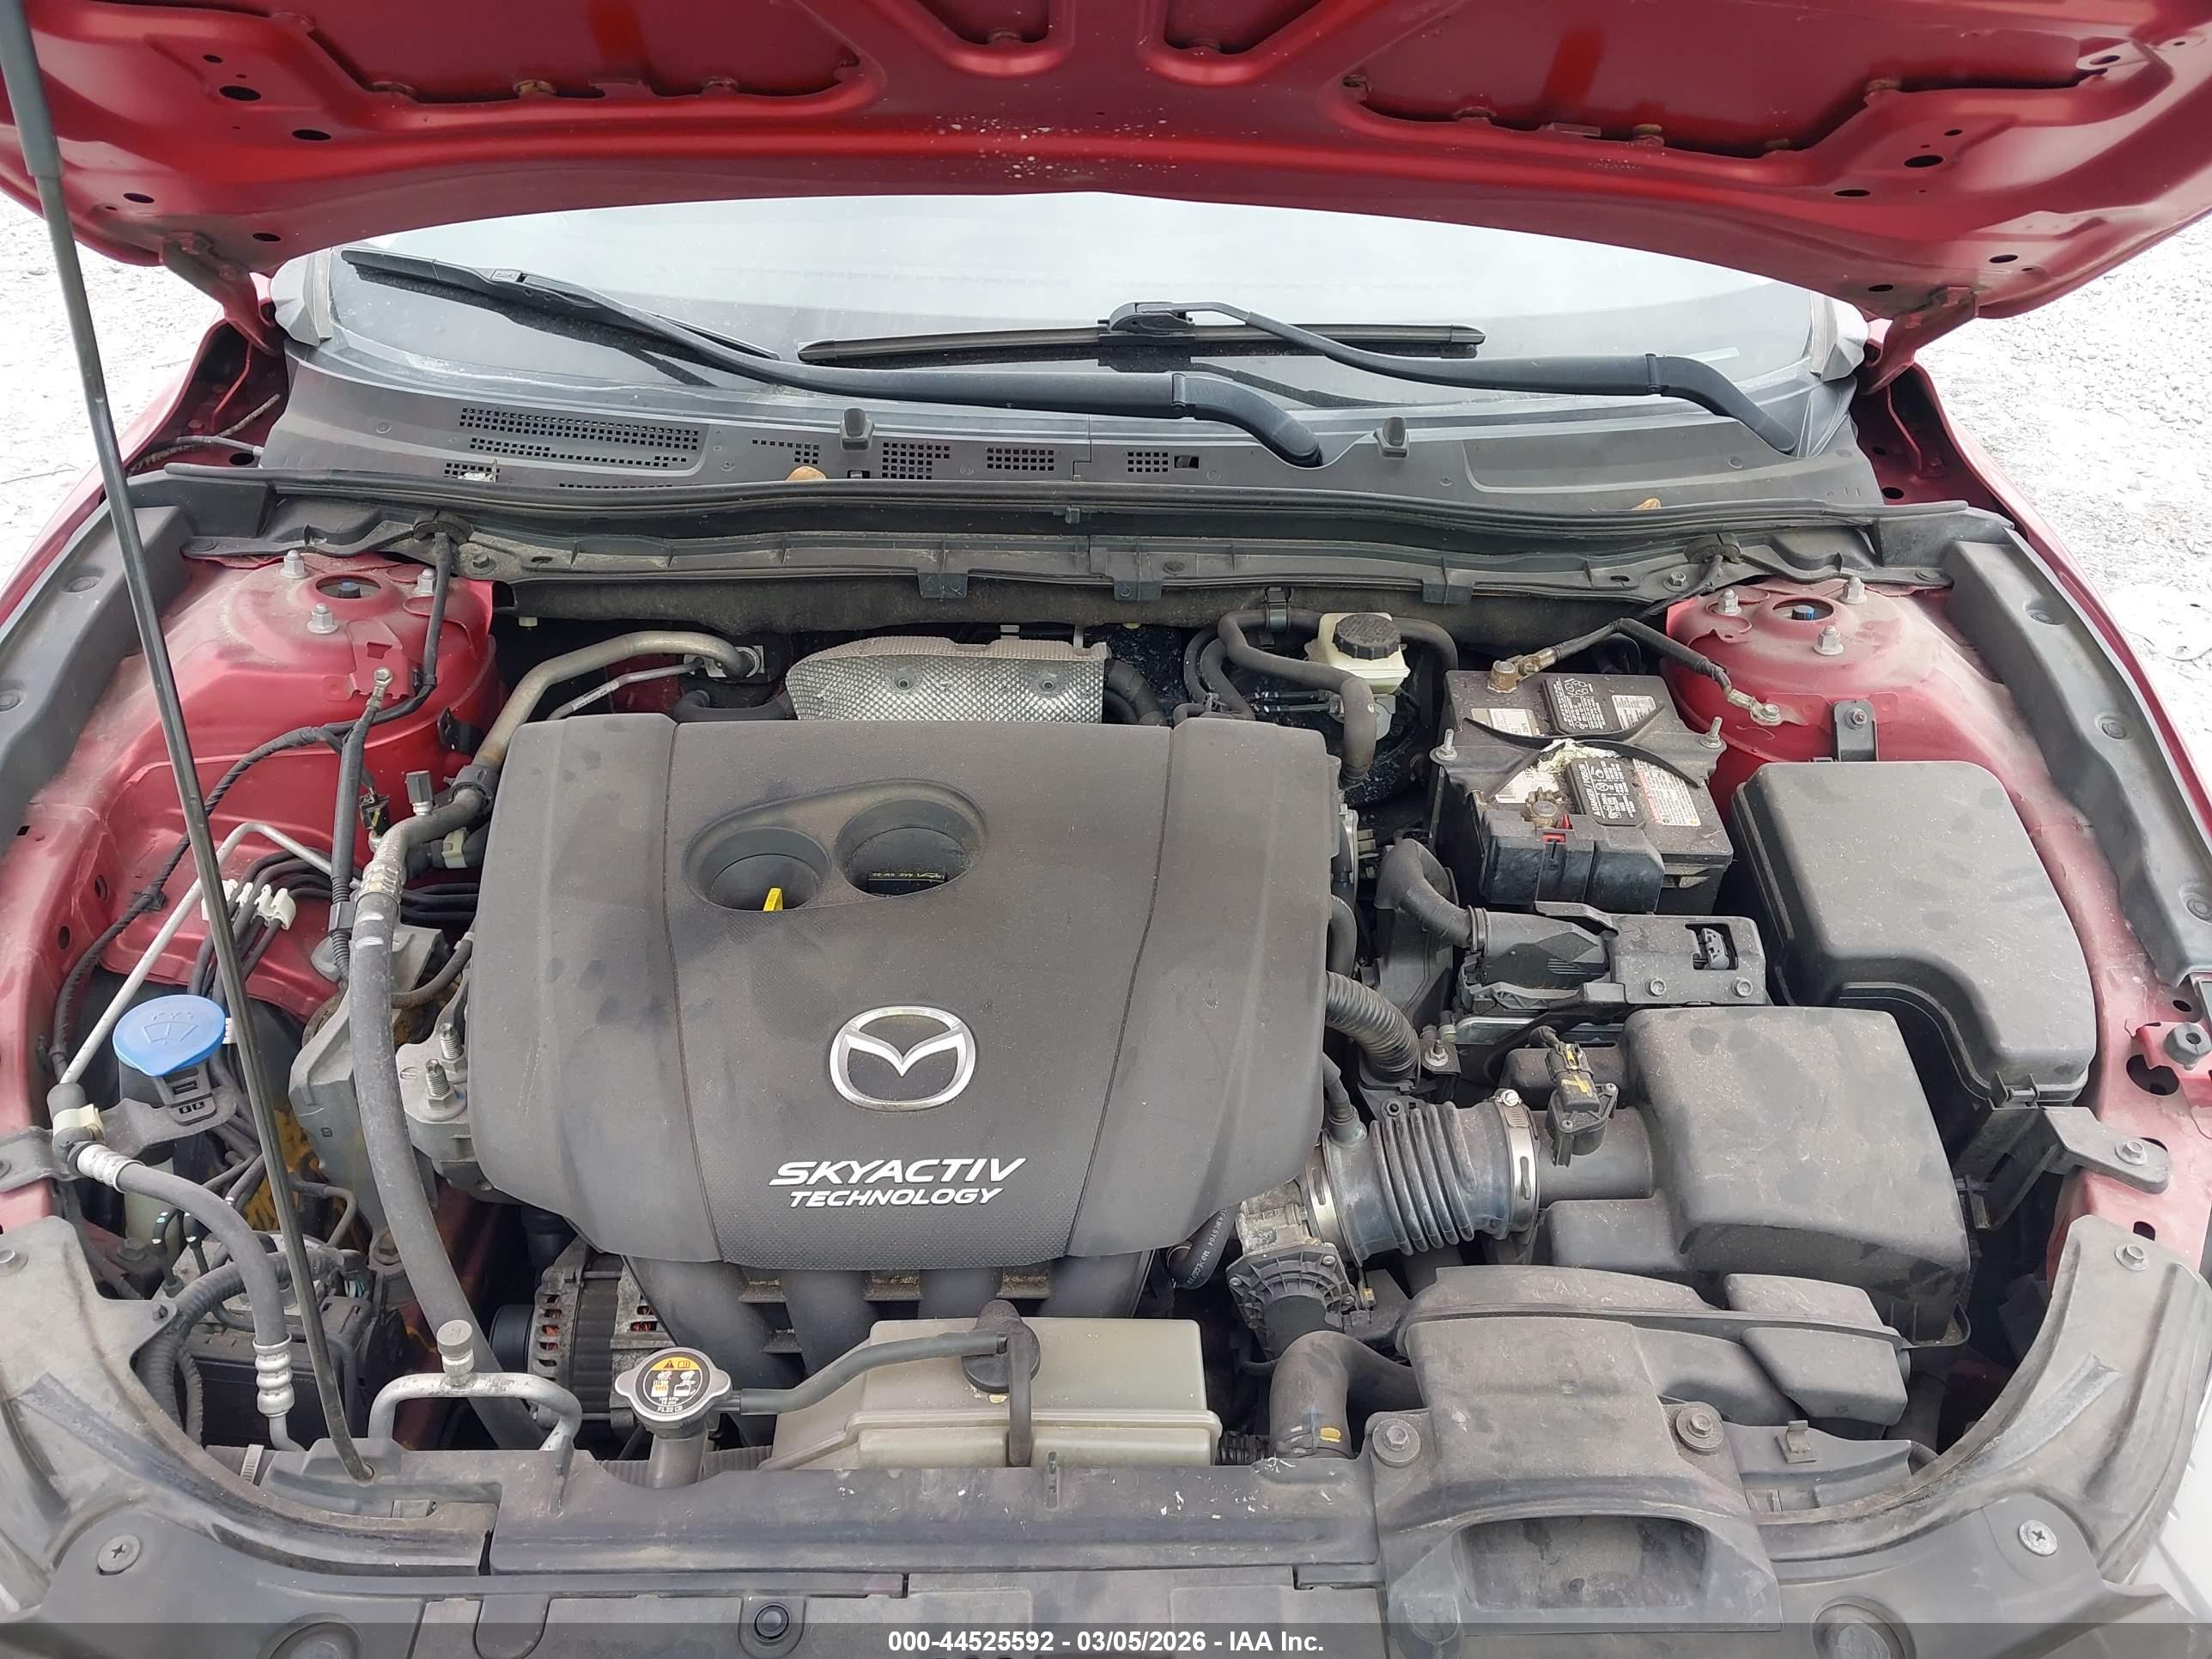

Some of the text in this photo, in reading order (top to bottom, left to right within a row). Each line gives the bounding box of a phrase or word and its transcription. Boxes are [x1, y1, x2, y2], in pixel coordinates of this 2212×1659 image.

[1577, 763, 1591, 783] POISON
[1586, 787, 1600, 811] DANGER
[769, 1158, 1026, 1186] SKYACTIV
[790, 1188, 1004, 1208] TECHNOLOGY
